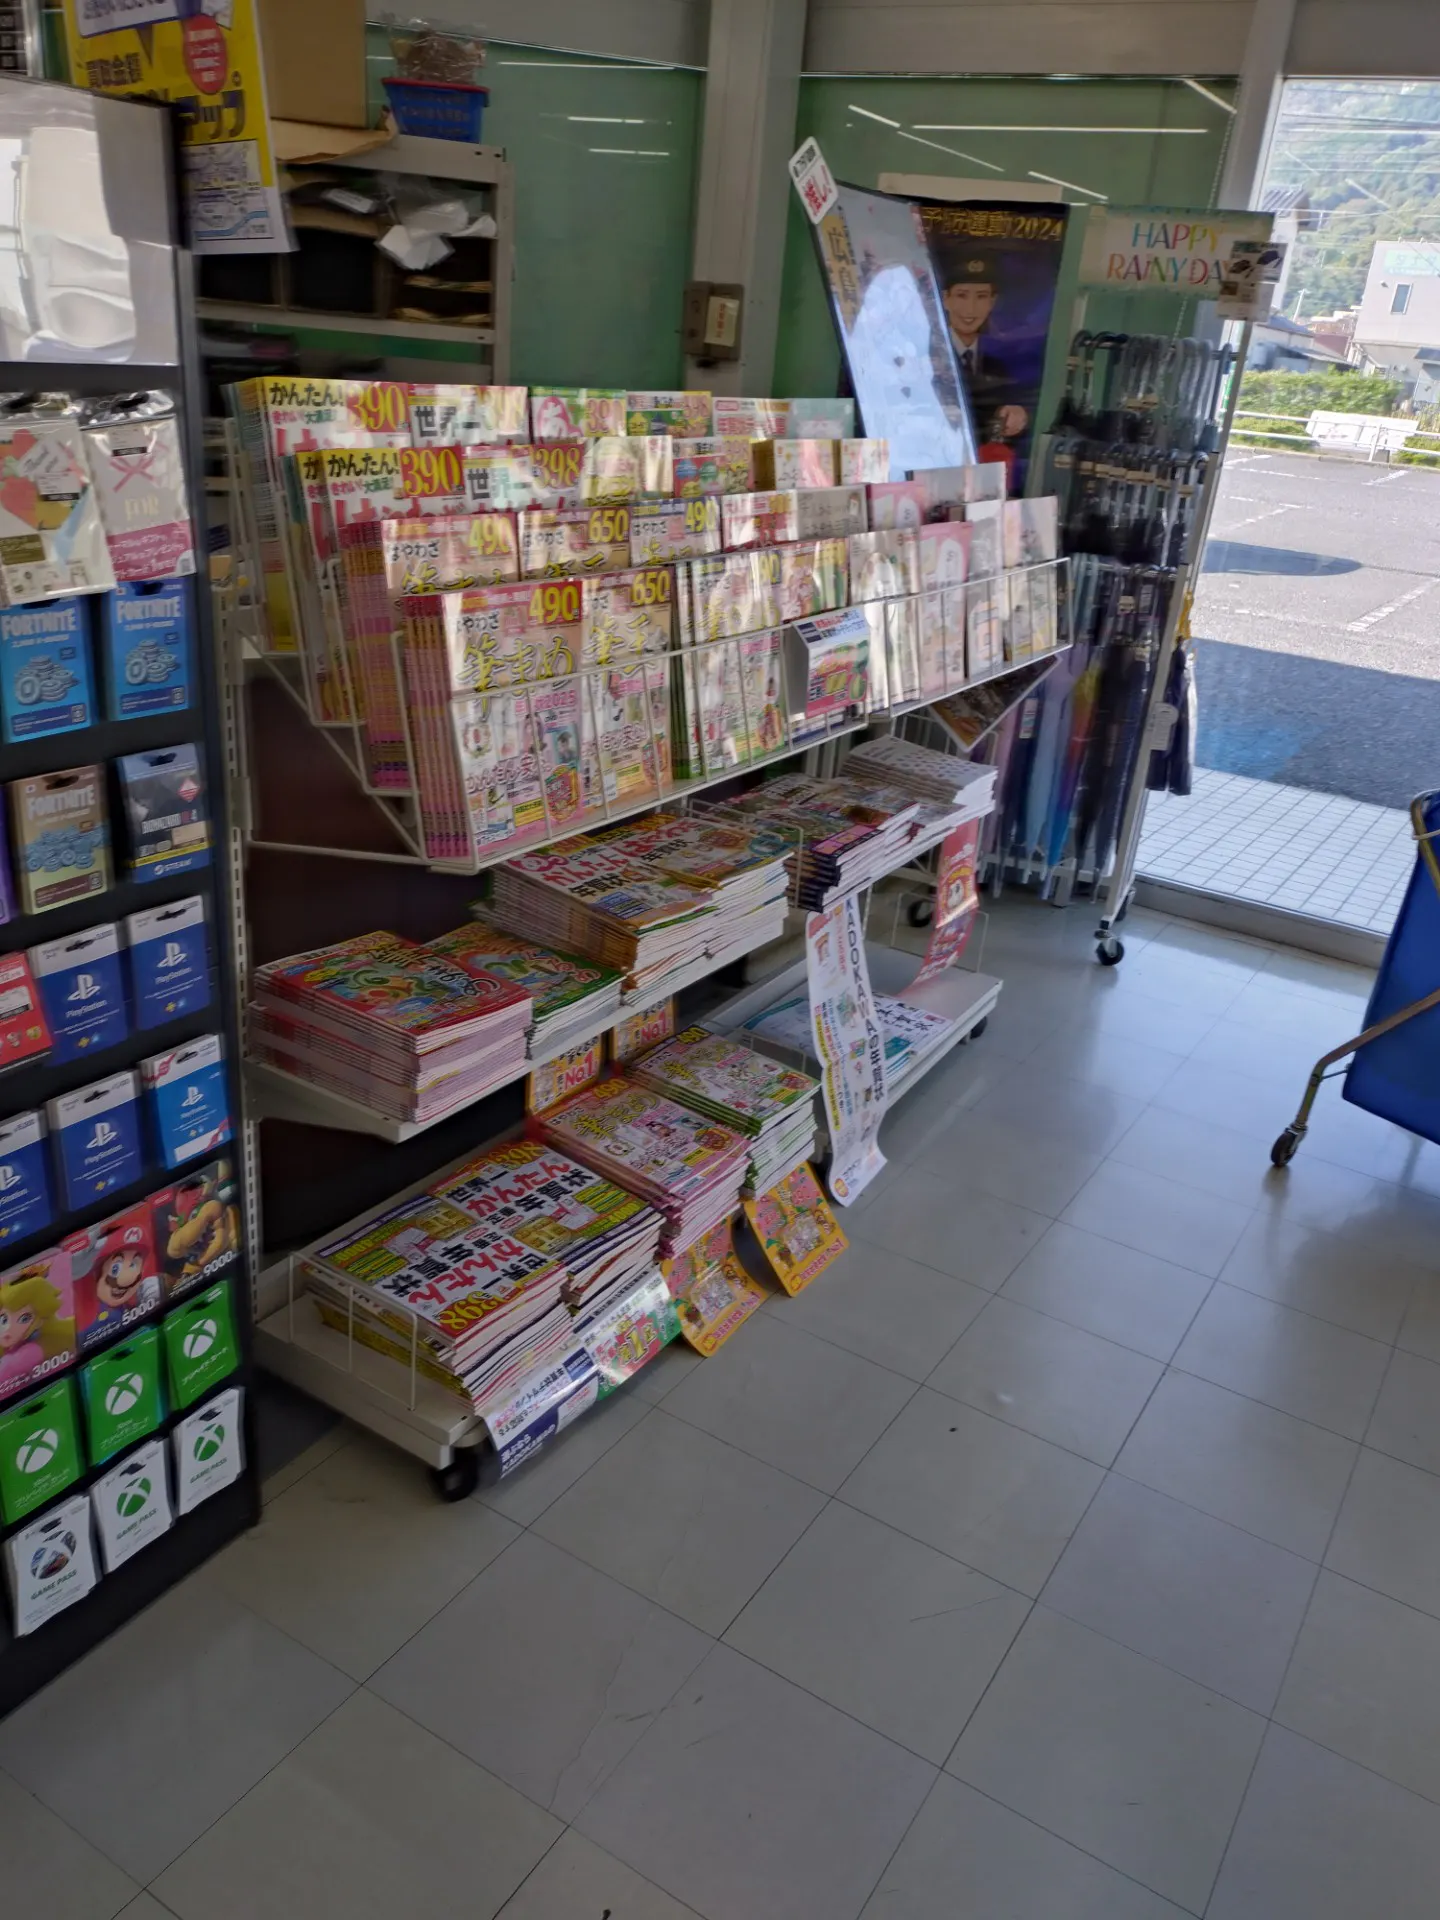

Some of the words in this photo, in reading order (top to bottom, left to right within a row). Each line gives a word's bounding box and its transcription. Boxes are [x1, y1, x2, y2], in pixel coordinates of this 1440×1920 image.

[1132, 222, 1224, 253] HAPPY
[327, 452, 400, 477] かんたん!
[402, 449, 461, 496] 390
[588, 509, 629, 543] 650
[684, 499, 719, 533] 490
[469, 516, 513, 556] 490
[528, 584, 579, 625] 490
[632, 570, 670, 605] 650
[1, 607, 76, 640] FORTNITE
[117, 595, 181, 623] FORTNITE
[28, 783, 96, 820] FORTNITE
[541, 851, 630, 886] かんたん
[65, 999, 107, 1019] PlayStation
[84, 1143, 124, 1166] PlayStation
[445, 1170, 511, 1203] 世界一
[466, 1161, 572, 1218] かんたん
[487, 1203, 518, 1227] 定番
[515, 1168, 595, 1214] 年賀状
[382, 1244, 475, 1298] 年賀状
[407, 1237, 526, 1306] かんたん
[481, 1252, 549, 1292] 世界一
[122, 1299, 155, 1325] 5000
[439, 1290, 499, 1331] 398
[32, 1350, 70, 1379] 3000
[30, 1580, 57, 1601] GAME
[56, 1568, 78, 1587] PASS
